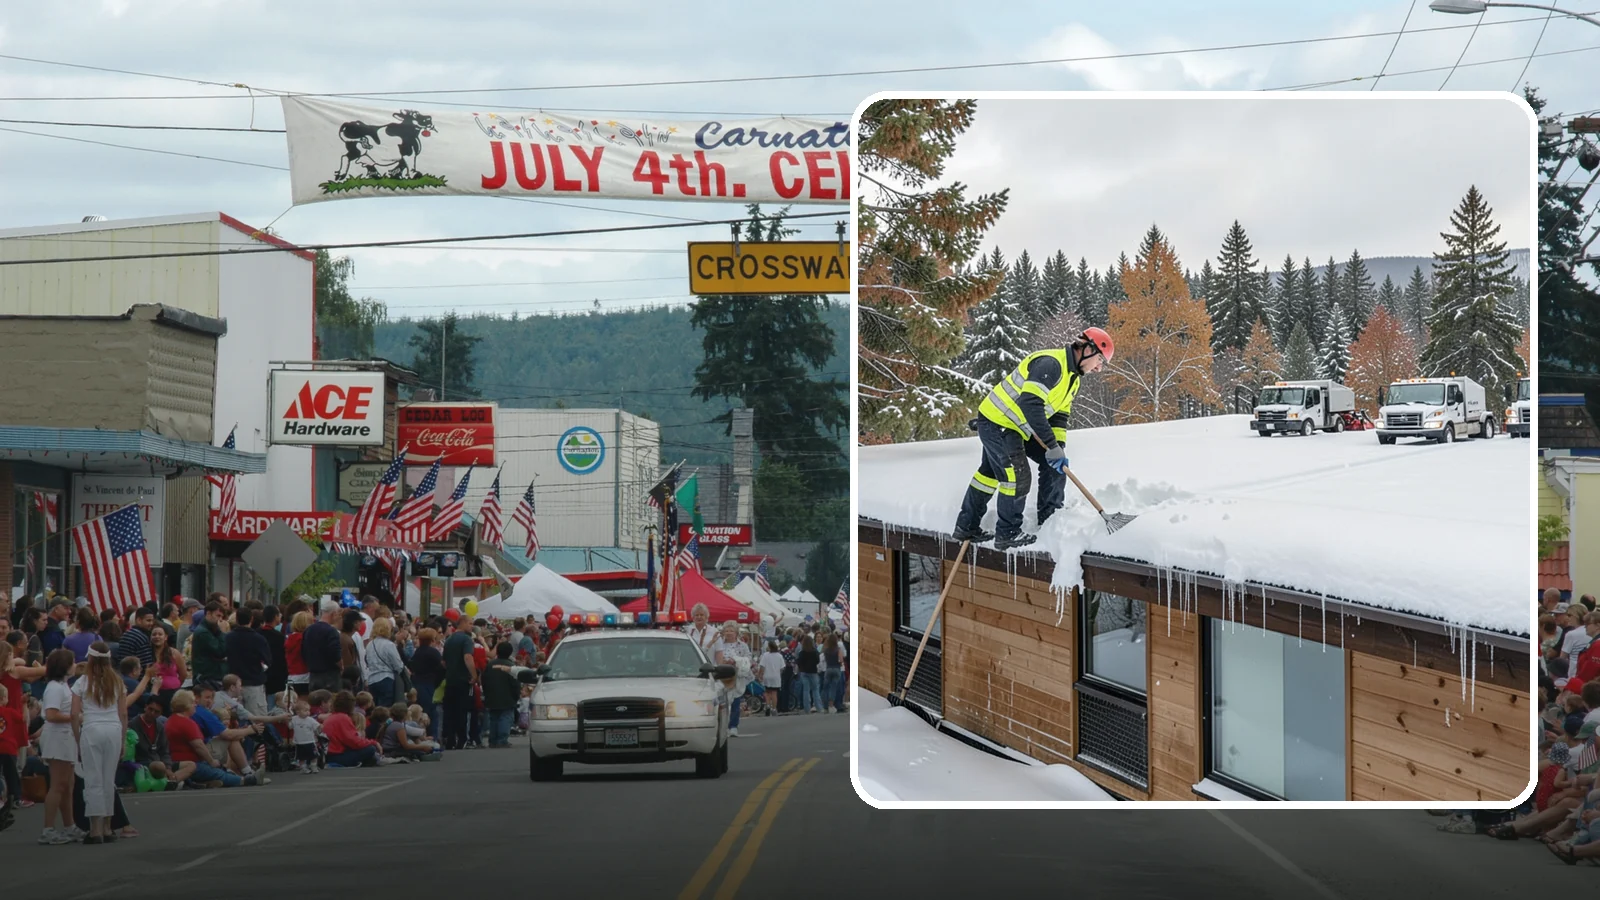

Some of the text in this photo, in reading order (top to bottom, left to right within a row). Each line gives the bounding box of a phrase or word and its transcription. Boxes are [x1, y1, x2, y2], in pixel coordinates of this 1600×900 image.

[481, 141, 605, 191] JULY
[632, 150, 746, 197] 4th.
[696, 254, 850, 280] CROSSWA
[282, 380, 373, 420] ACE
[406, 409, 485, 421] CEDAR LOG
[283, 421, 371, 436] Hardware
[353, 467, 386, 480] Simpl
[96, 485, 124, 494] Vincent
[126, 486, 136, 494] de
[138, 486, 155, 495] Paul
[688, 526, 741, 535] CRNATION
[699, 535, 730, 543] GLASS
